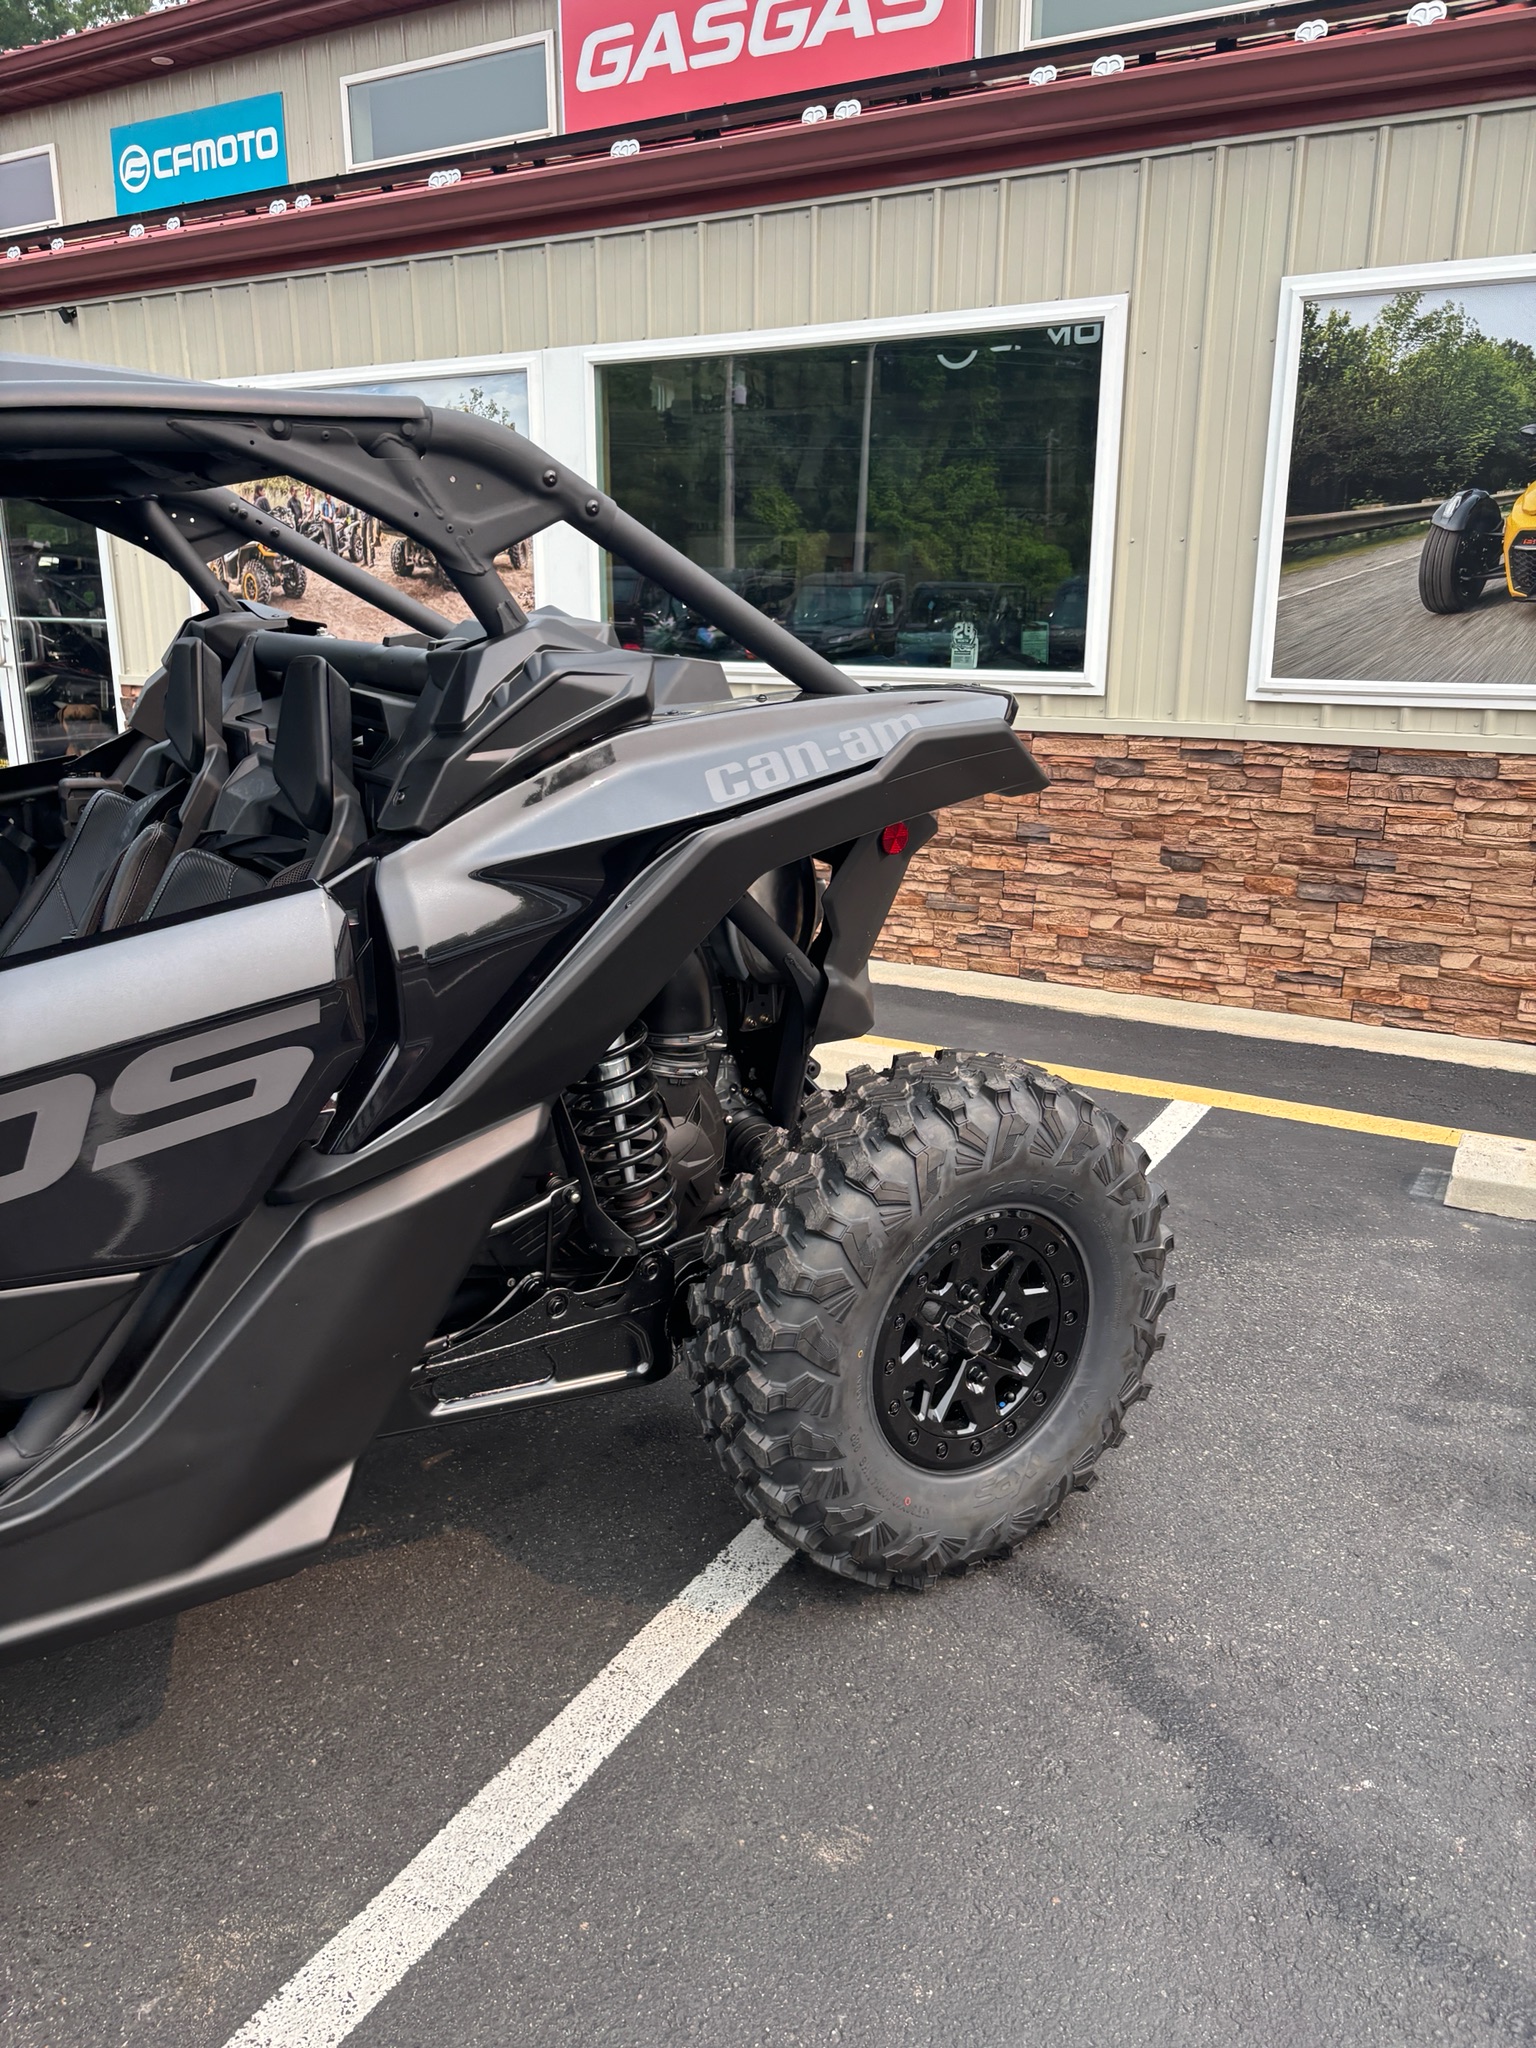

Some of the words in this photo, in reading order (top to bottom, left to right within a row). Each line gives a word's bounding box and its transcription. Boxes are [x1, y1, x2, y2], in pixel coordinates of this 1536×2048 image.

[576, 0, 944, 93] GASGAS
[152, 126, 279, 180] CFMOTO
[704, 713, 924, 803] can-am
